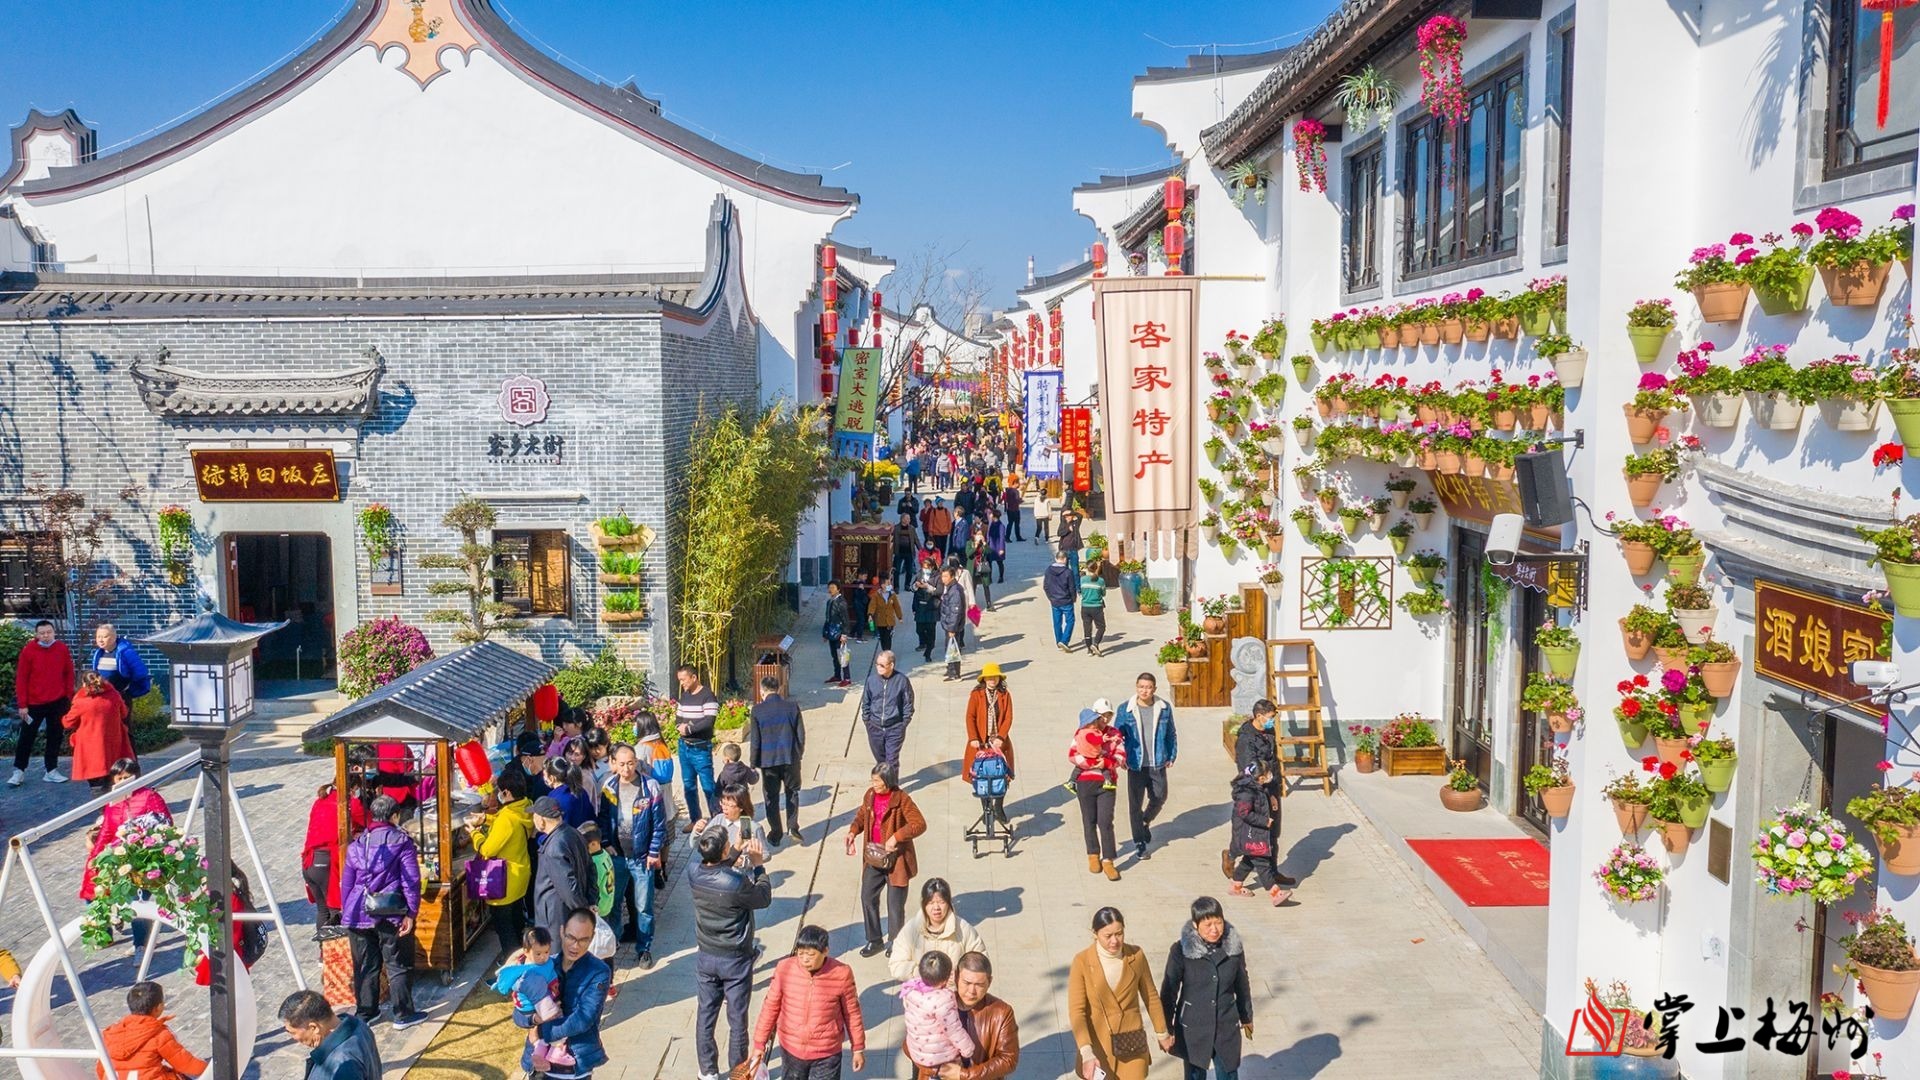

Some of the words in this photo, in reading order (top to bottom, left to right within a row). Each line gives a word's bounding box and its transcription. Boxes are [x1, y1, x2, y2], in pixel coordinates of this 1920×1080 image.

[842, 351, 871, 431] 密室大逃脱
[1129, 320, 1173, 480] 客家特产
